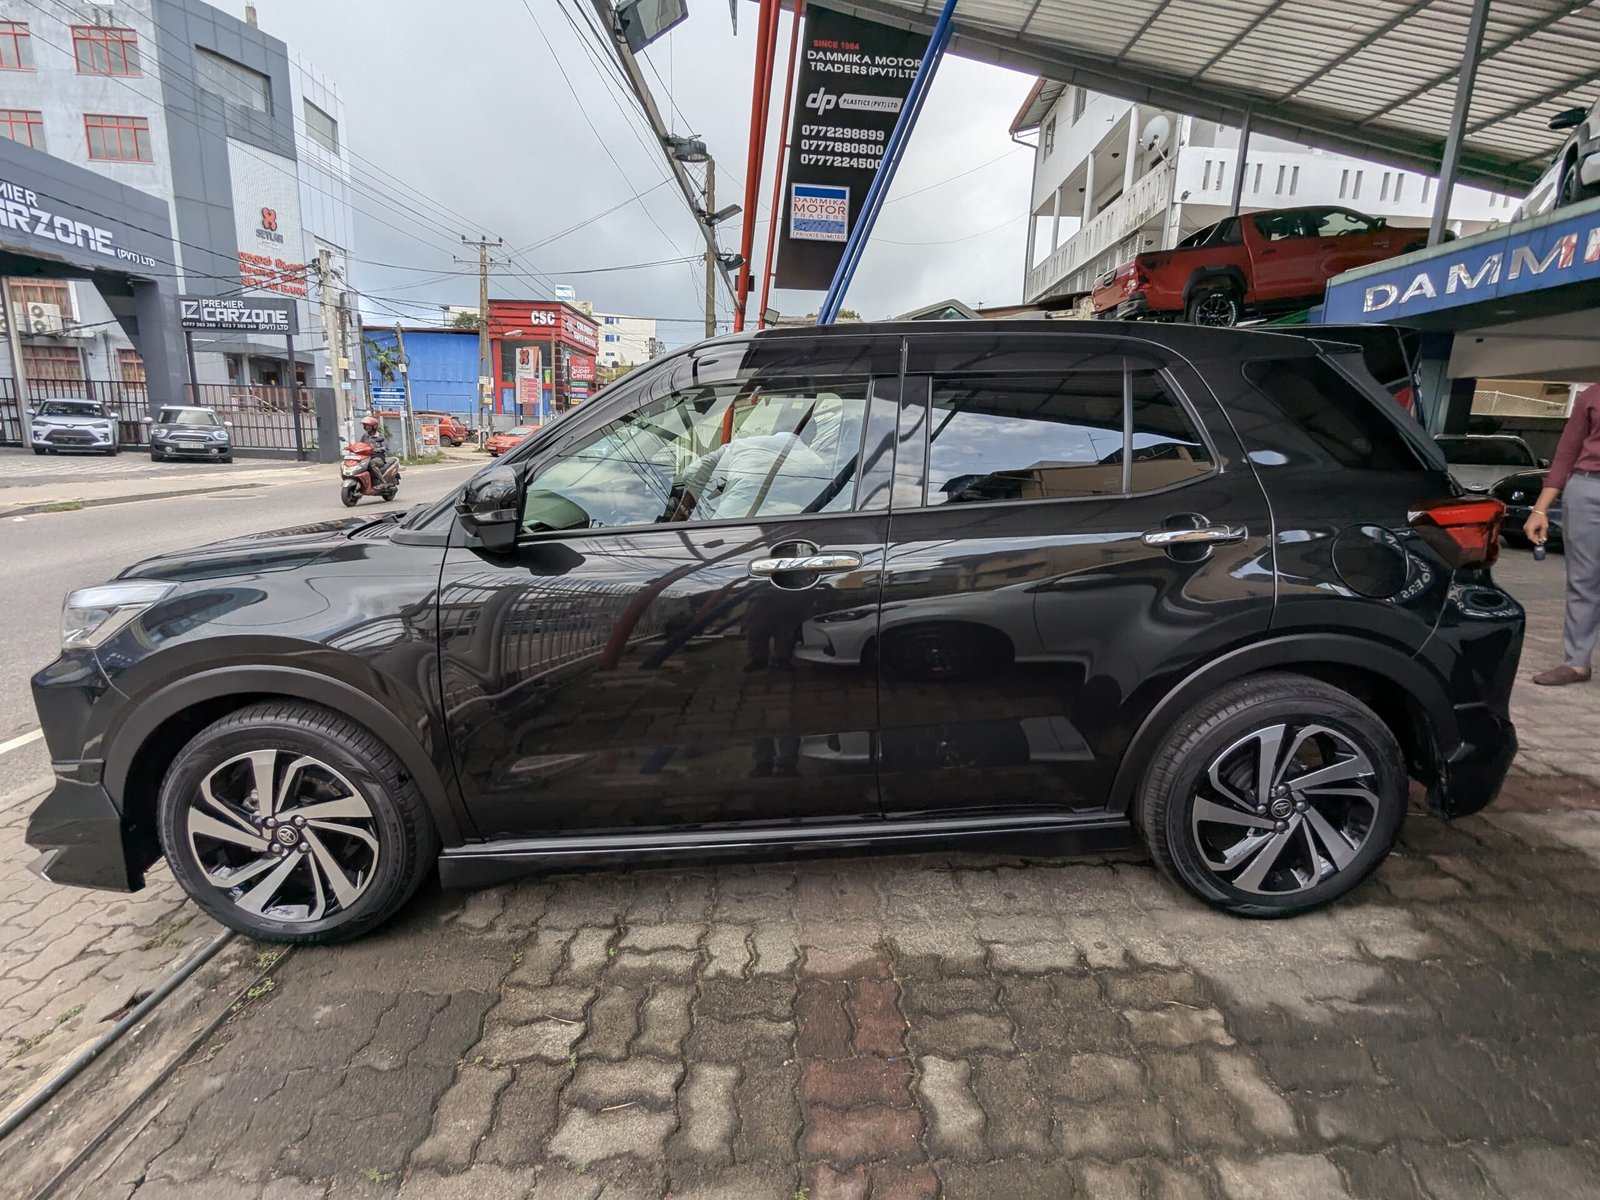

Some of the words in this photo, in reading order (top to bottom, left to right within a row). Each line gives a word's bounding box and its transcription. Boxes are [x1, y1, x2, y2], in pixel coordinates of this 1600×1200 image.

[813, 40, 838, 48] SINCE
[807, 50, 871, 64] DAMMIKA
[874, 56, 923, 68] MOTOR
[810, 61, 867, 75] TRADERS
[868, 66, 897, 78] (PVT)
[898, 69, 918, 79] LTD
[805, 86, 837, 116] dp
[843, 98, 870, 106] PLASTICS
[870, 100, 886, 108] (PVT)
[801, 124, 885, 141] 0772298899
[801, 139, 884, 156] 0777880800
[800, 154, 882, 169] 0777224500
[793, 203, 846, 215] MOTOR
[794, 197, 846, 206] DAMMIKA
[794, 212, 846, 221] TRADERS
[117, 248, 139, 264] (PVT)
[140, 256, 155, 267] LTD
[202, 299, 244, 308] PREMIER
[203, 308, 288, 323] CARZONE
[531, 310, 555, 325] CSC
